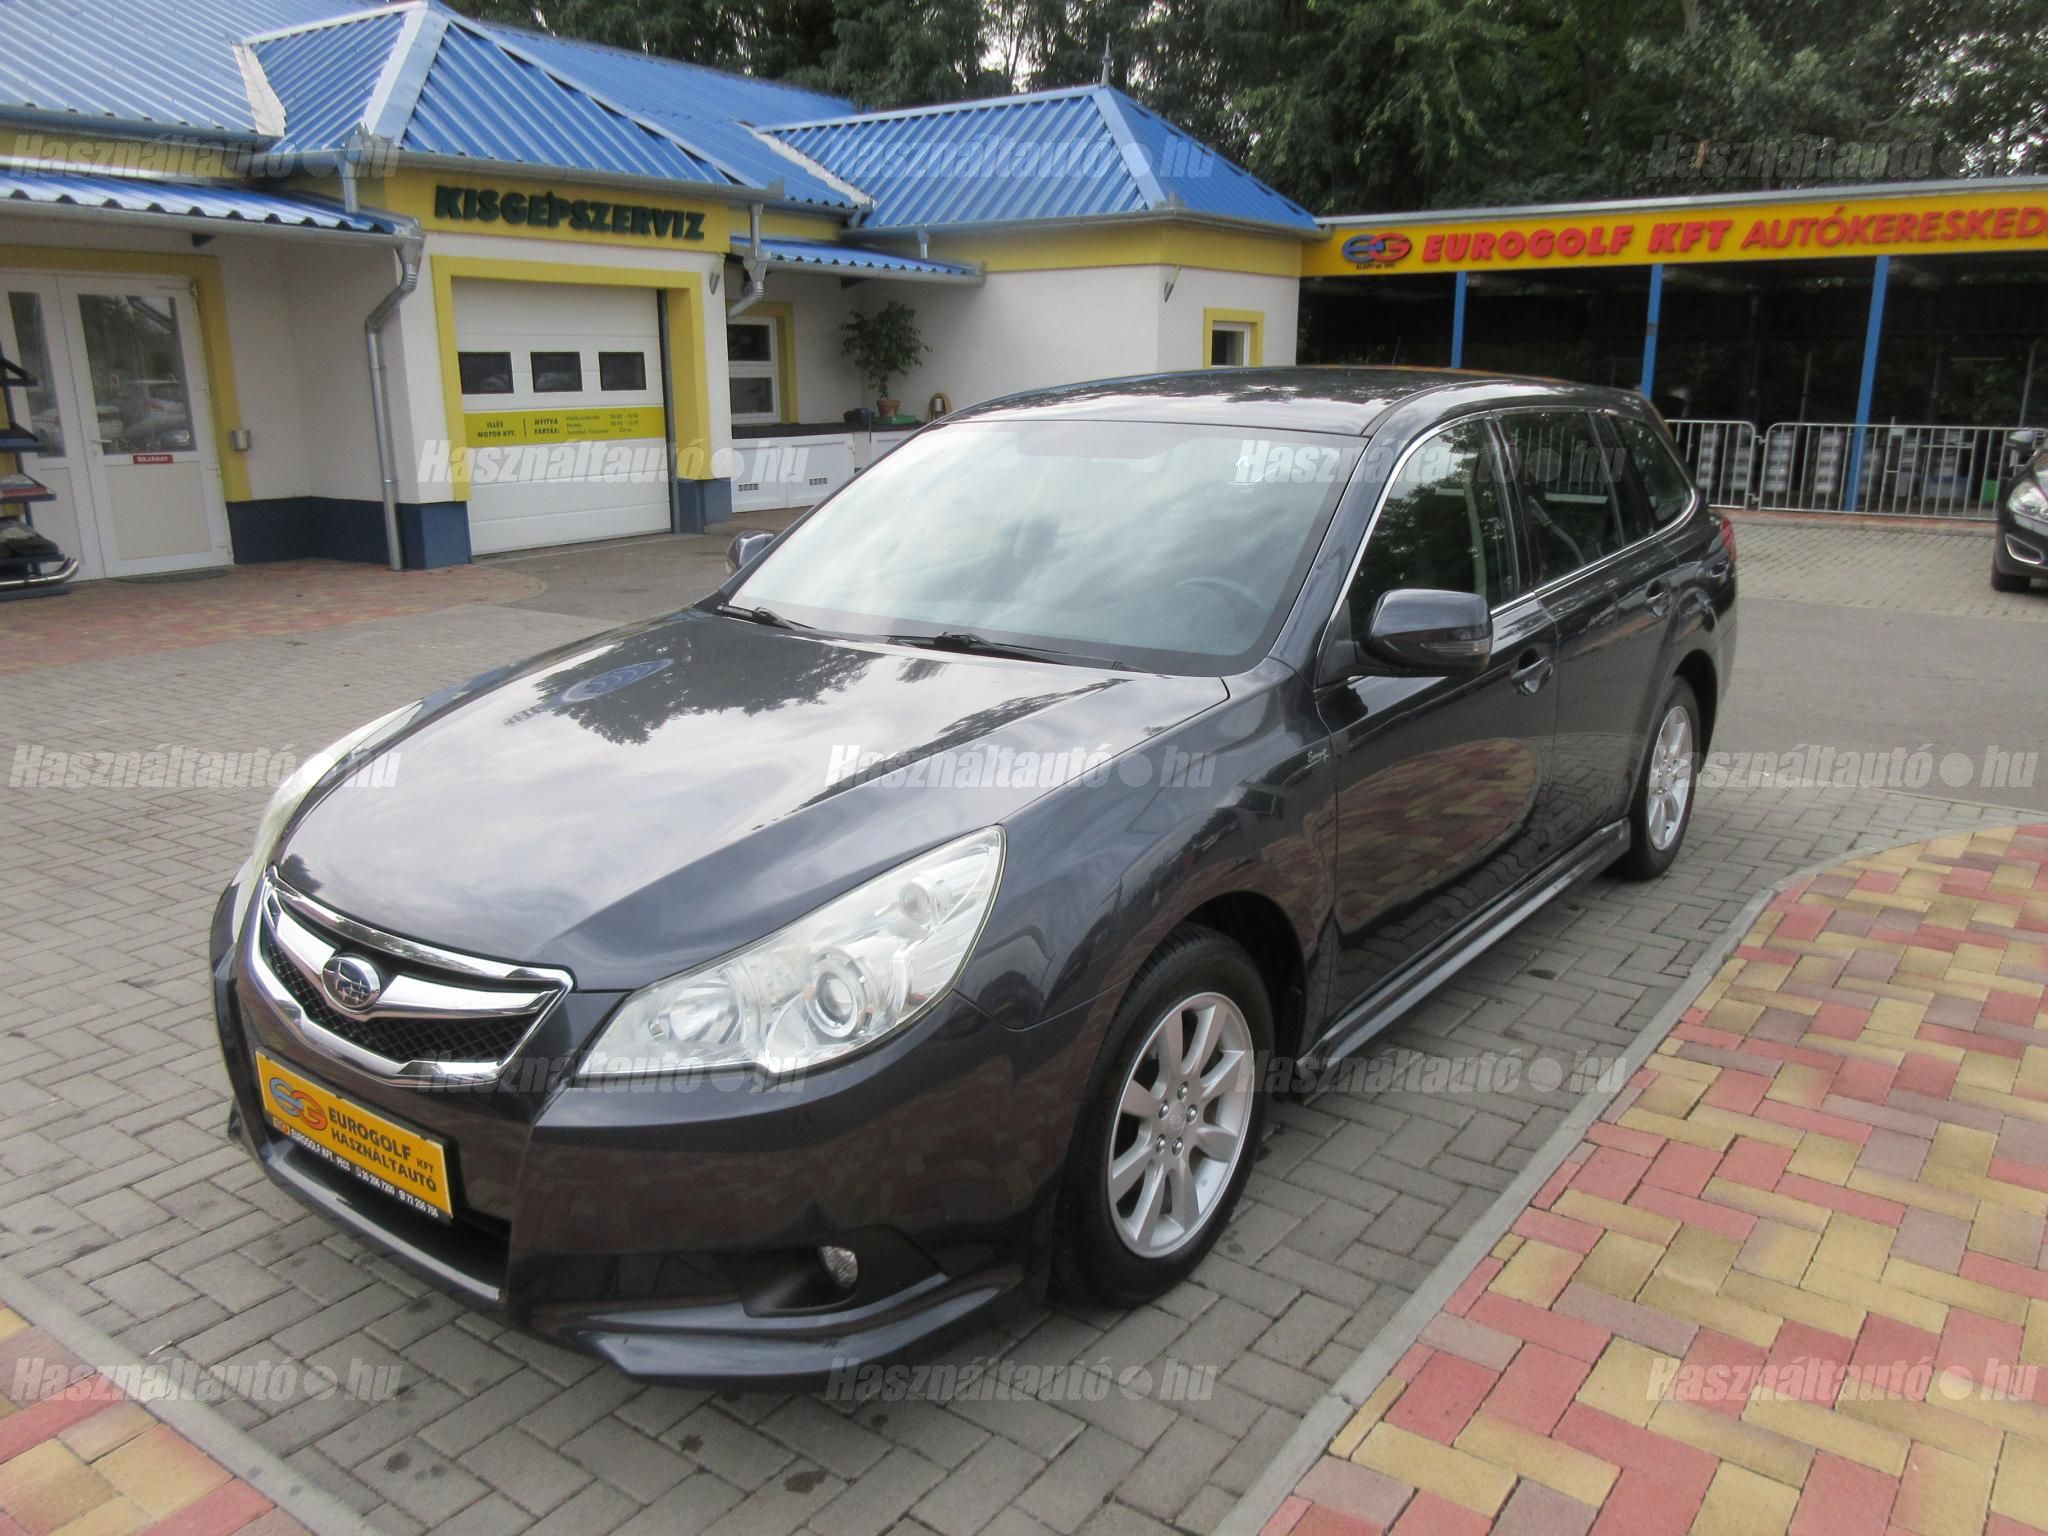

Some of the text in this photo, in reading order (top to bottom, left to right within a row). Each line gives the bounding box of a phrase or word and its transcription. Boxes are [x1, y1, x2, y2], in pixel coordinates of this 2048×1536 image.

[435, 184, 705, 241] KISGÉPSZERVIZ
[1422, 225, 1634, 262] EUROGOLF
[1648, 219, 1733, 253] KFT
[1741, 205, 2048, 250] AUTÓKERESKED
[329, 1106, 411, 1160] EUROGOLF
[416, 1158, 434, 1173] KFT
[331, 1128, 437, 1192] HASZNÁLTAUTÓ
